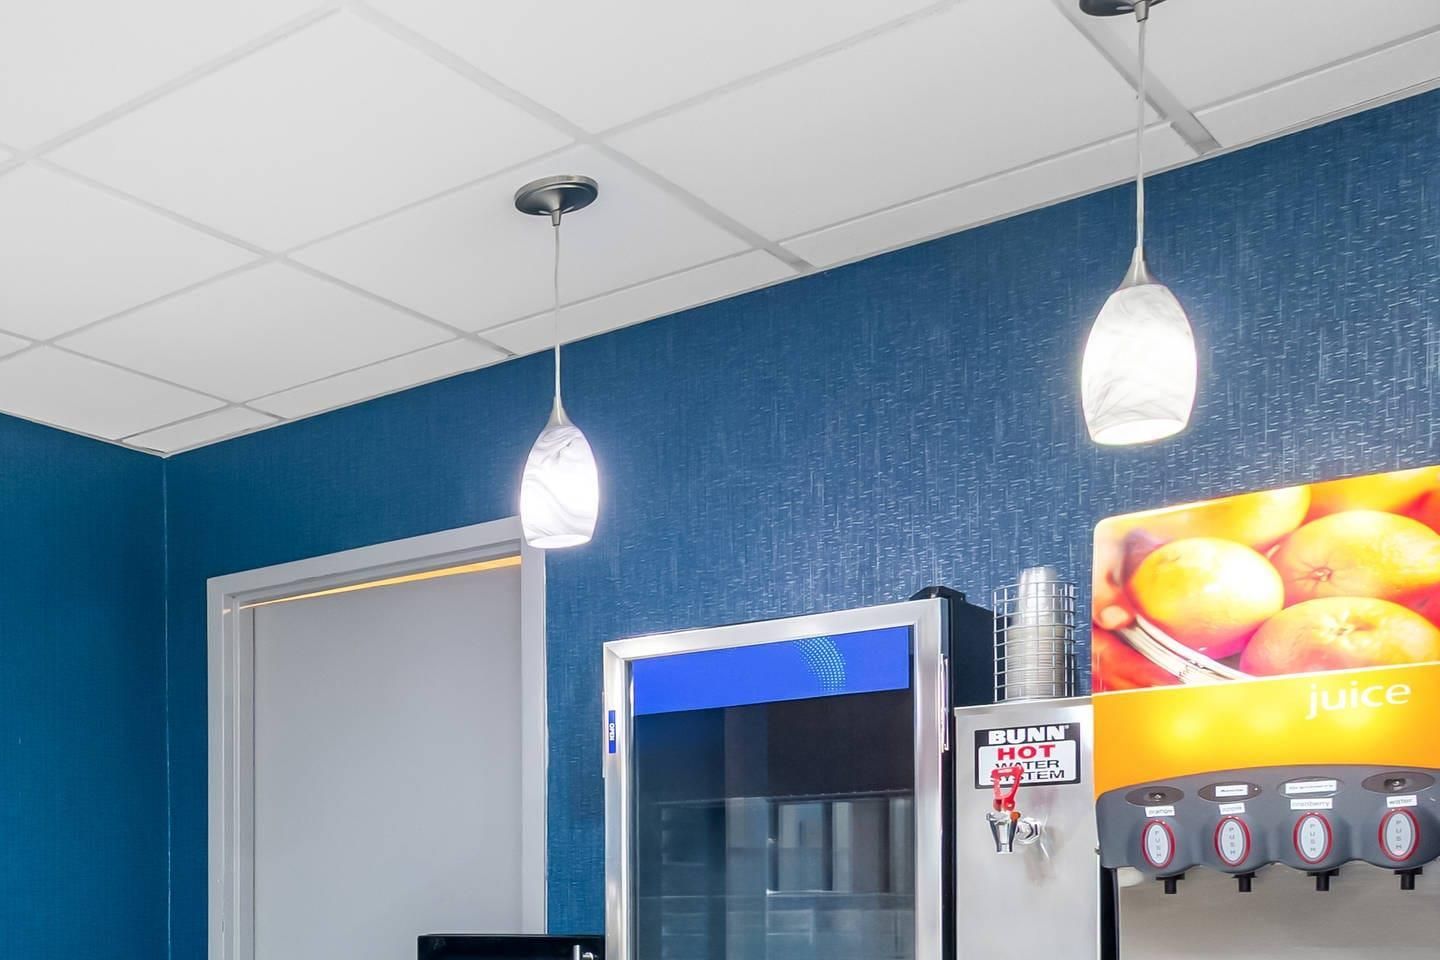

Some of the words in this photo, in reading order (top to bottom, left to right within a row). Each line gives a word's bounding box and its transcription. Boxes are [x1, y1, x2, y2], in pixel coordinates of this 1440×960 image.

[1304, 680, 1412, 720] juice
[988, 725, 1065, 745] BUNN
[997, 744, 1056, 760] HOT
